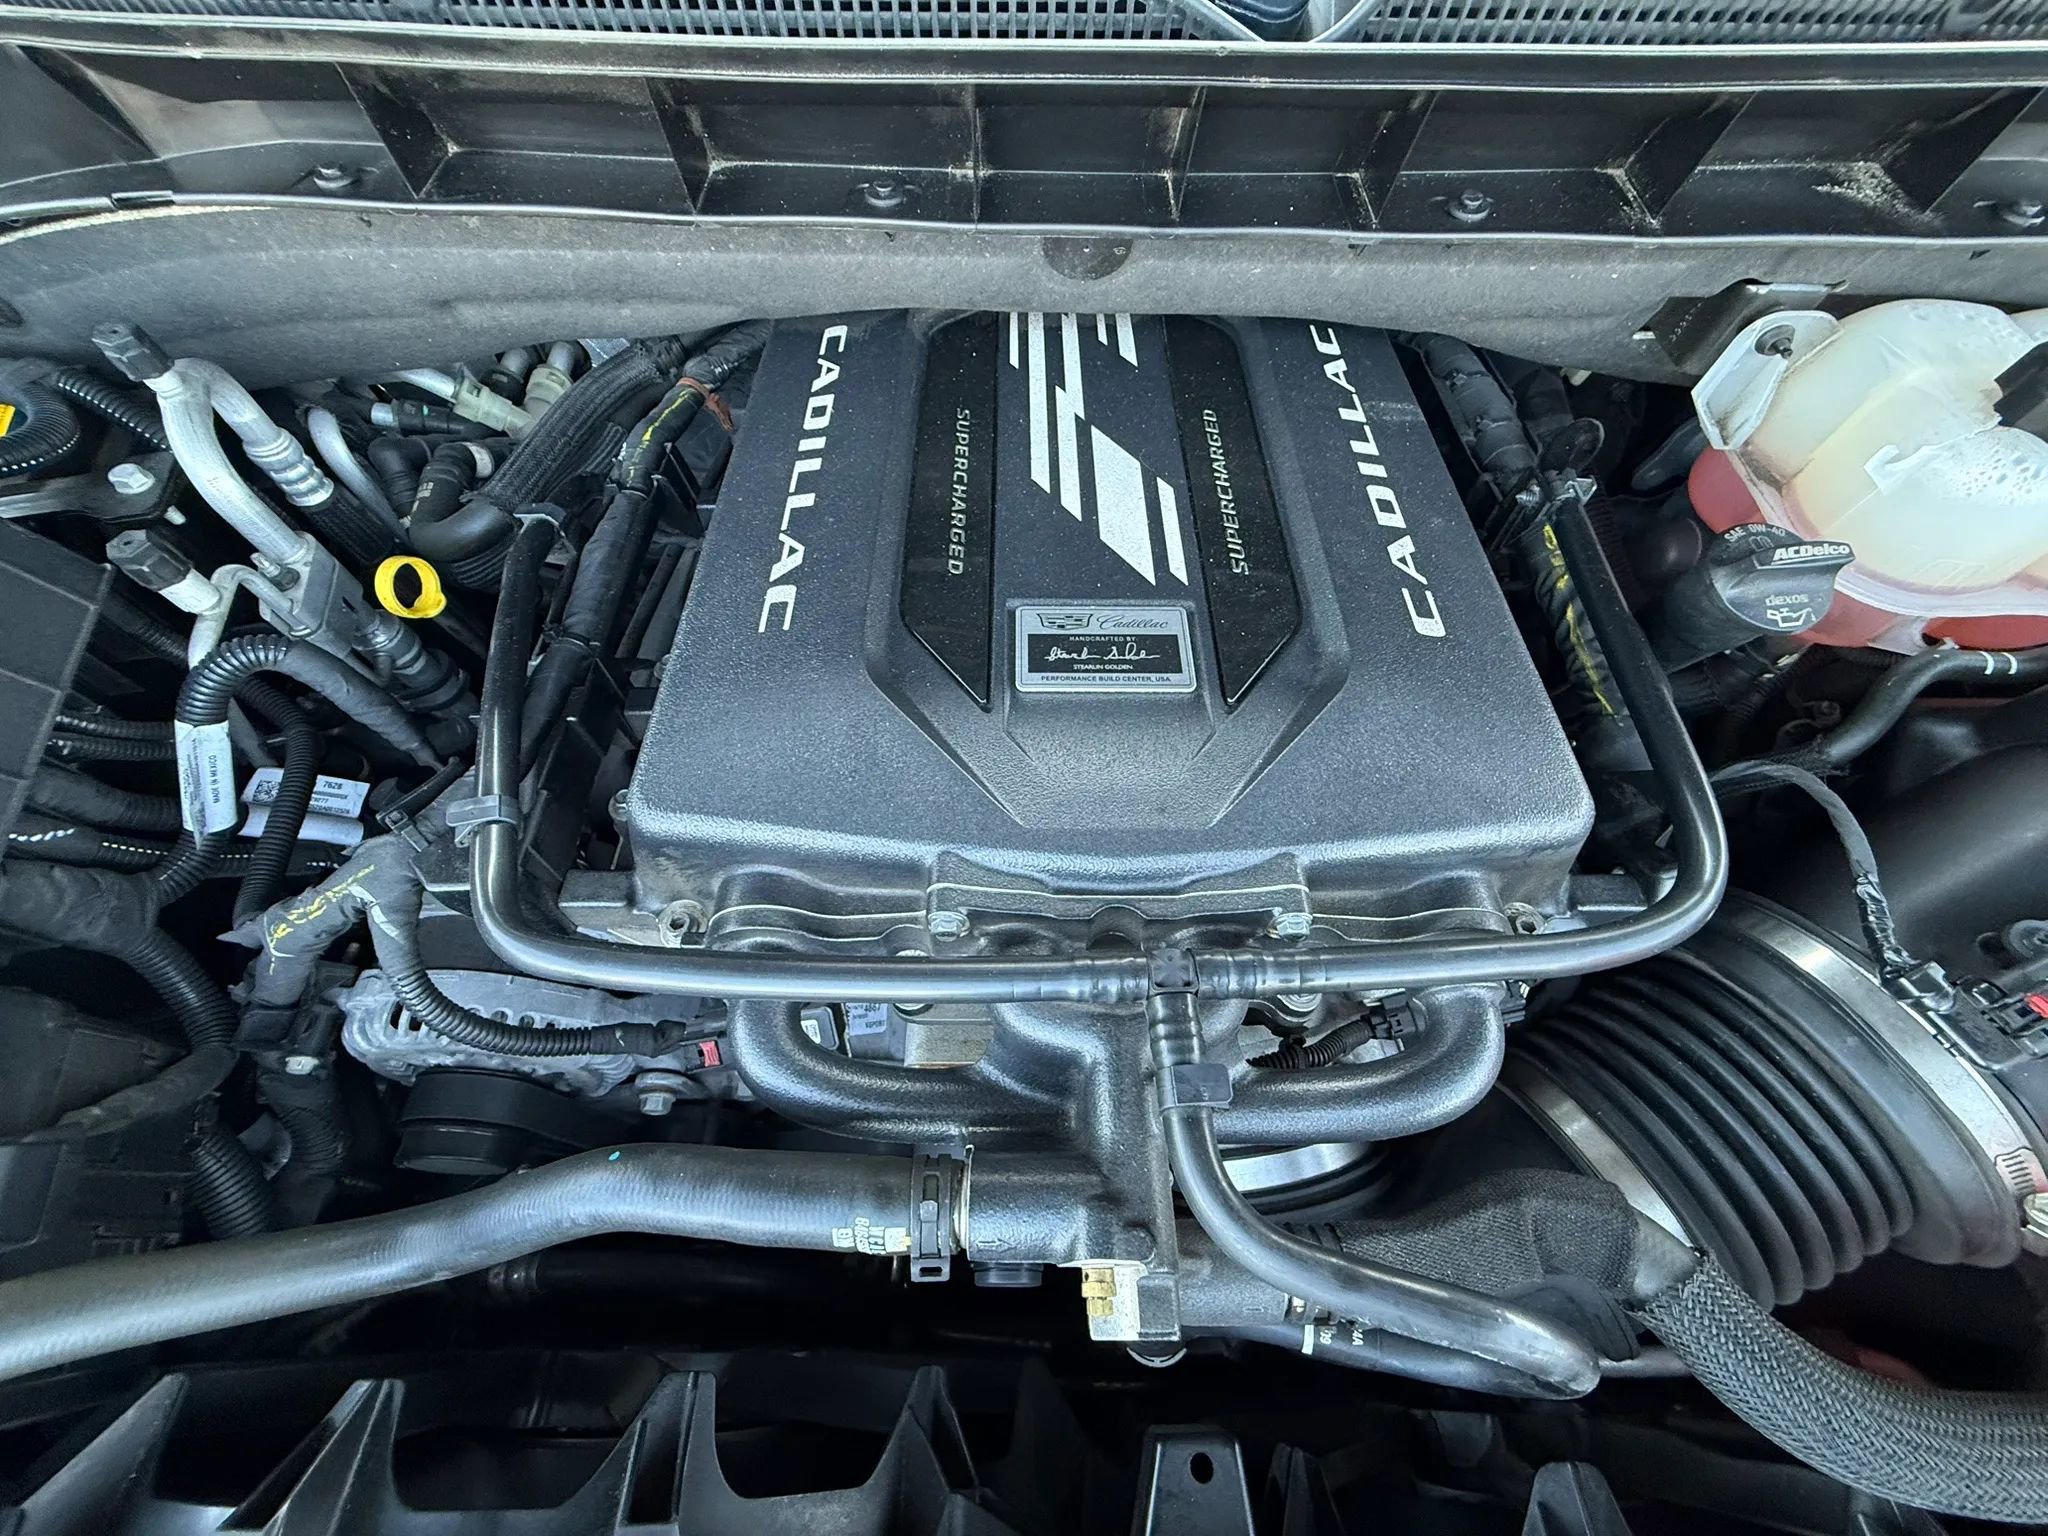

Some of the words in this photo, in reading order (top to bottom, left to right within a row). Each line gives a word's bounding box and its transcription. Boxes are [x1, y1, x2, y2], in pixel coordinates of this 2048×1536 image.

[757, 324, 848, 633] CADILLAC
[948, 407, 971, 575] SUPERCHARGED
[1202, 409, 1249, 576] SUPERCHARGED
[1309, 324, 1447, 638] CADILLAC
[1723, 527, 1746, 543] SAE
[1772, 543, 1850, 561] ACDelco
[1096, 614, 1169, 630] Cadillac
[1765, 593, 1810, 607] dexos
